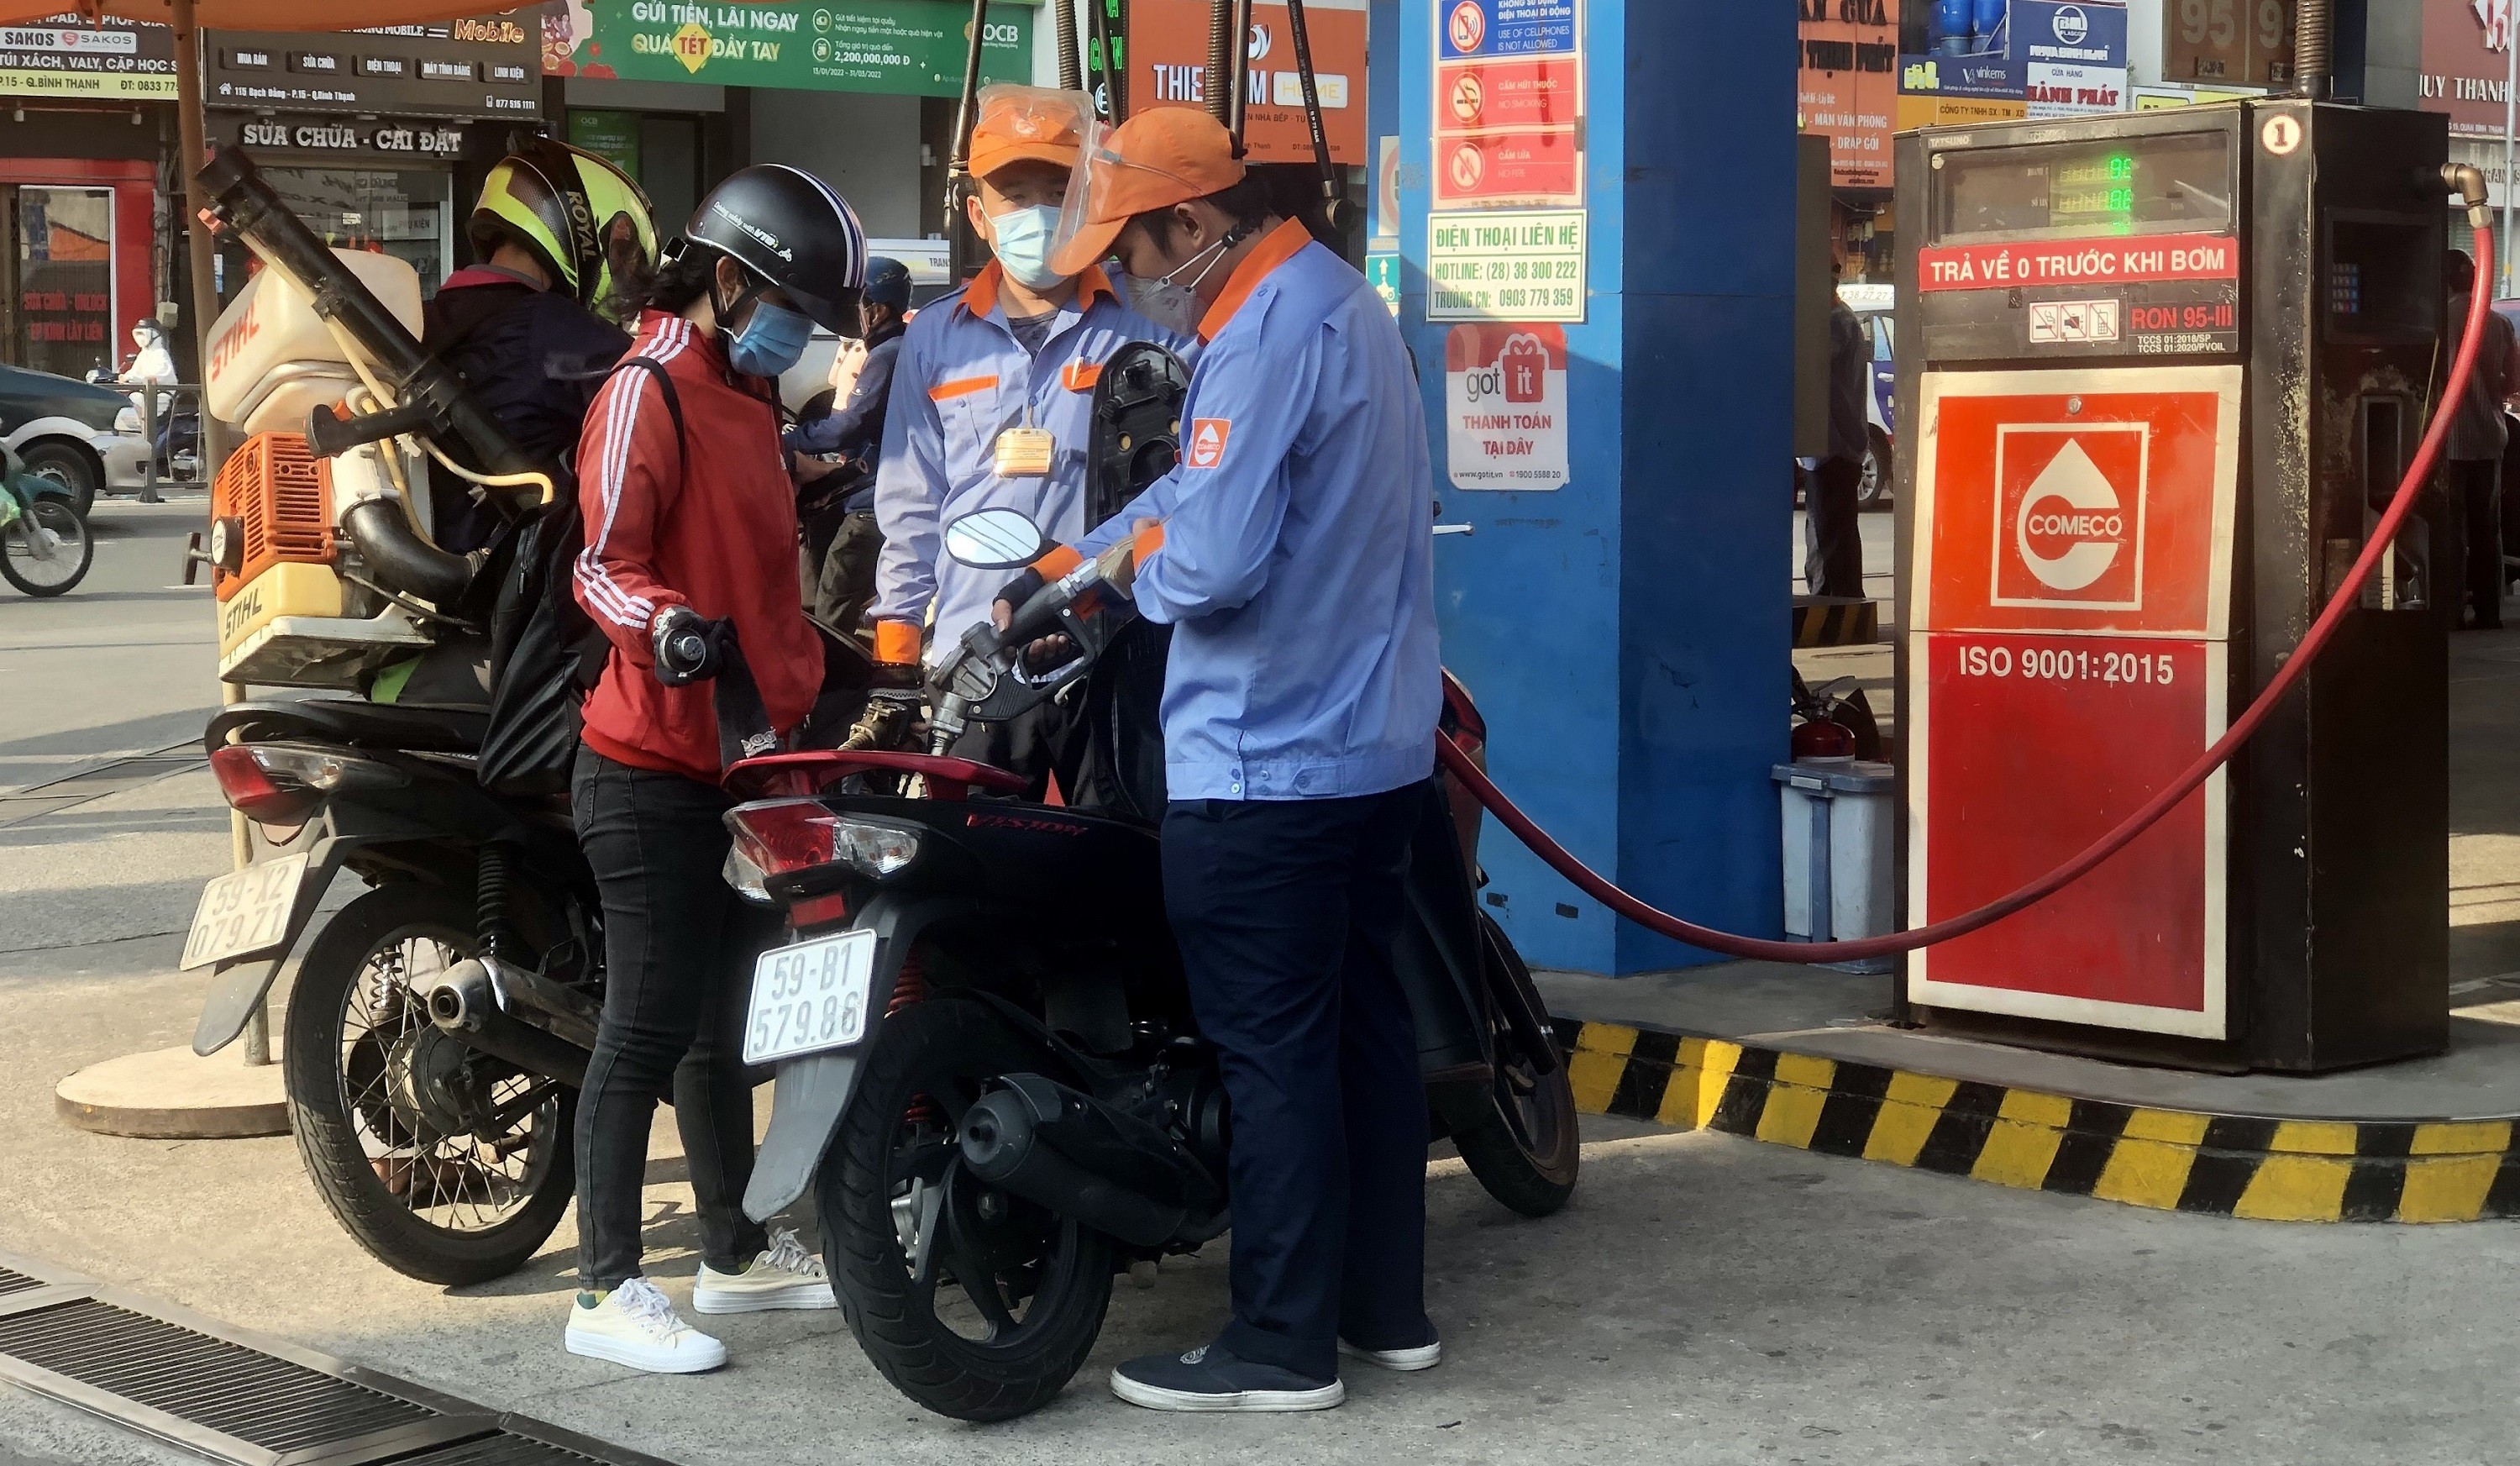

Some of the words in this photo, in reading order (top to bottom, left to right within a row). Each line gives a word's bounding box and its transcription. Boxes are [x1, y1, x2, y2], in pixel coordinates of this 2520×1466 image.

[750, 13, 799, 32] NGAY
[1516, 9, 1539, 18] THOẠI
[1541, 8, 1548, 17] DI
[5, 31, 55, 46] SAKOS
[81, 34, 132, 45] SAKOS
[454, 18, 525, 44] Mobile
[983, 24, 1018, 42] OCB
[1498, 29, 1511, 39] USE
[1513, 28, 1523, 37] OF
[1525, 26, 1570, 36] CELLPHONES
[679, 31, 707, 55] TẾT
[752, 41, 780, 60] TAY
[1498, 43, 1504, 51] IS
[1505, 41, 1521, 50] NOT
[1522, 39, 1558, 49] ALLOWED
[68, 56, 102, 71] VALY,
[137, 59, 168, 74] HỌC
[834, 51, 901, 66] 2,200,000,000
[1976, 65, 2007, 81] vinkems
[66, 78, 100, 92] THẠNH
[137, 81, 161, 91] 0833
[234, 87, 247, 97] 115
[2454, 77, 2510, 102] THANH
[496, 98, 508, 108] 077
[1512, 99, 1547, 108] SMOKING
[2077, 84, 2119, 106] PHÁT
[1814, 110, 1835, 126] MÀN
[1961, 107, 1968, 115] TY
[1970, 107, 1987, 116] TNHH
[244, 119, 289, 146] SỬA
[296, 123, 358, 149] CHỮA
[1837, 137, 1861, 150] DRAP
[1929, 134, 1970, 148] TATSUNO
[2274, 122, 2288, 147] 1
[566, 191, 596, 262] ROYAL
[1436, 225, 1469, 251] ĐIỆN
[1475, 227, 1517, 251] THOẠI
[1522, 223, 1554, 246] LIÊN
[1559, 222, 1578, 250] HỆ
[1435, 262, 1483, 281] HOTLINE:
[1486, 262, 1509, 282] (28)
[1514, 262, 1530, 280] 38
[1532, 262, 1552, 279] 300
[1556, 261, 1577, 279] 222
[1931, 253, 1975, 282] TRẢ
[1981, 250, 2011, 280] VỀ
[2018, 259, 2030, 278] 0
[2035, 249, 2116, 277] TRƯỚC
[2124, 252, 2164, 273] KHI
[2171, 246, 2225, 271] BƠM
[1435, 285, 1473, 308] TRƯỞNG
[1475, 291, 1492, 308] CN:
[1499, 289, 1525, 307] 0903
[1530, 289, 1550, 306] 779
[1553, 288, 1573, 306] 359
[2131, 307, 2177, 328] RON
[2183, 305, 2233, 328] 95-III
[211, 299, 260, 383] STIHL
[2138, 336, 2162, 344] TCCS
[2164, 334, 2211, 344] 01:2018/SP
[2138, 344, 2162, 353] TCCS
[2164, 342, 2226, 352] 01:2020/PVOIL
[1466, 368, 1501, 402] got
[1517, 365, 1532, 395] it
[1462, 414, 1511, 429] THANH
[1514, 411, 1551, 429] TOÁN
[1483, 440, 1504, 459] TẠI
[1458, 470, 1504, 480] www.gotit.vn
[1515, 470, 1533, 479] 1900
[2028, 513, 2124, 537] COMECO
[224, 586, 263, 642] STIHL
[1960, 646, 2012, 676] ISO
[2021, 649, 2174, 685] 9001:2015
[212, 865, 290, 915] 59-X2
[772, 942, 852, 1000] 59-B1
[753, 990, 860, 1054] 579.86
